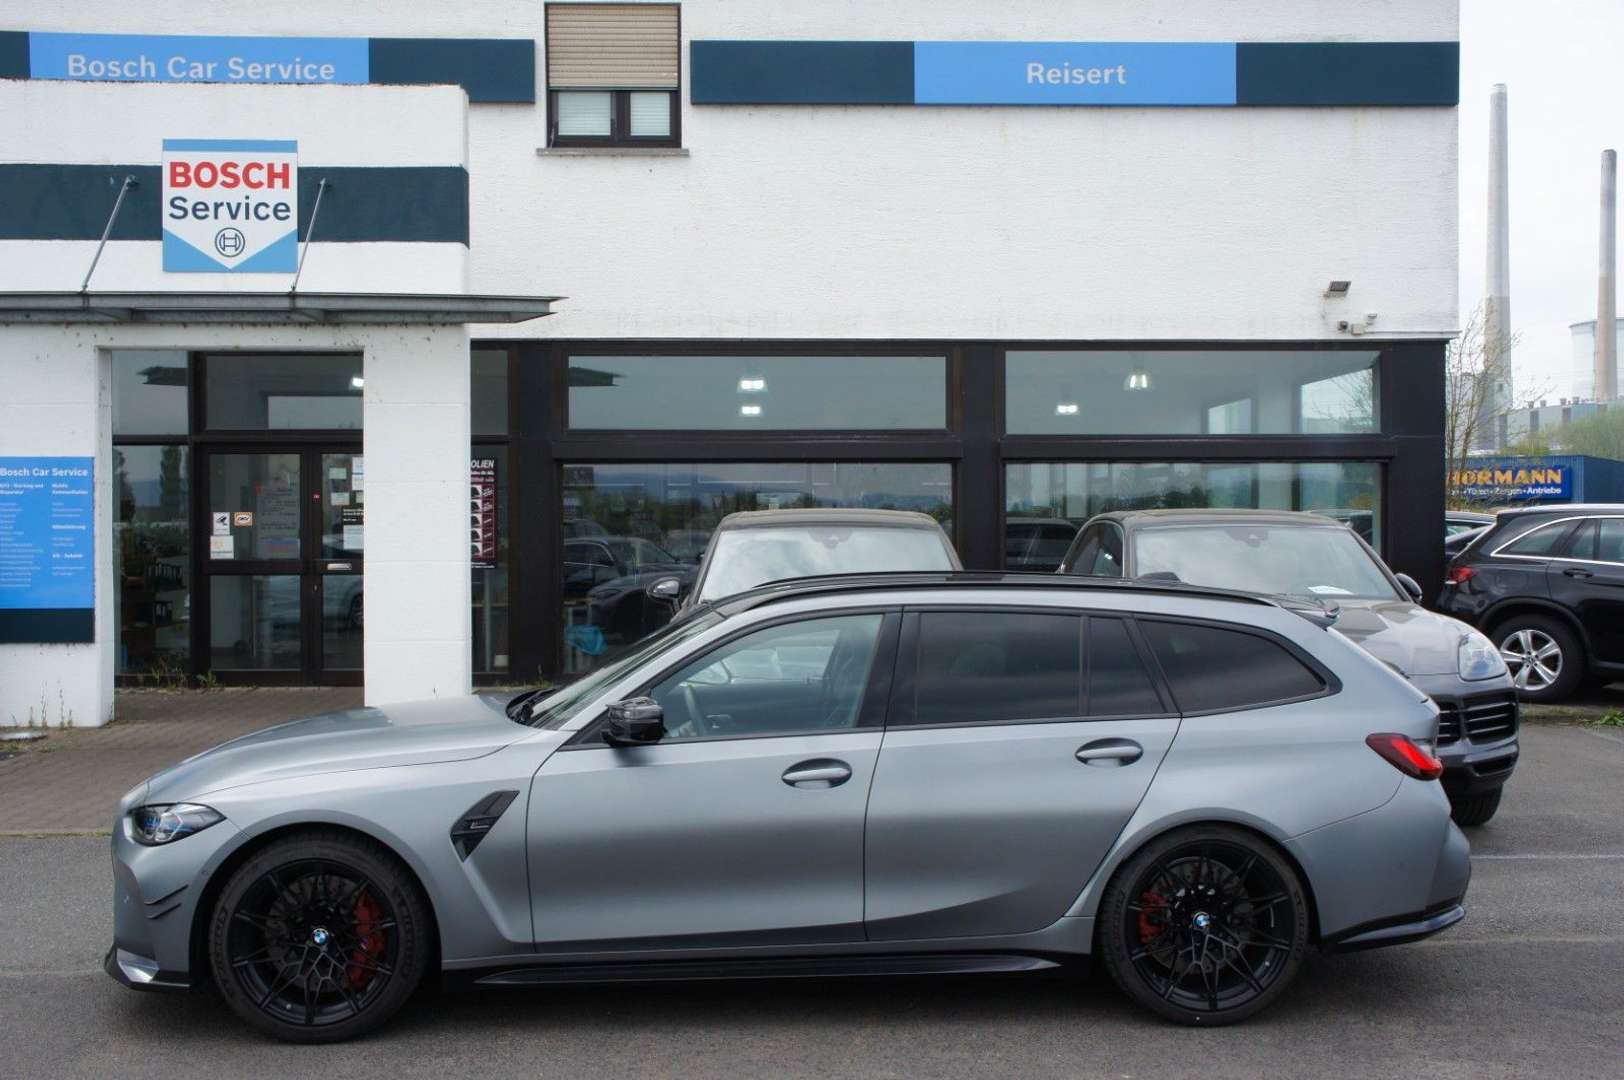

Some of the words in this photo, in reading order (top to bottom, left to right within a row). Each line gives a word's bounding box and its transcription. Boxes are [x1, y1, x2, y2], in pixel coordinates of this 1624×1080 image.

[67, 54, 156, 79] Bosch
[167, 56, 218, 80] Car
[228, 56, 336, 81] Service
[1026, 62, 1127, 85] Reisert
[169, 161, 290, 190] BOSCH
[169, 195, 291, 221] Service
[0, 467, 30, 477] Bosch
[32, 467, 49, 477] Car
[52, 467, 88, 477] Service
[1527, 486, 1562, 495] Antriebe
